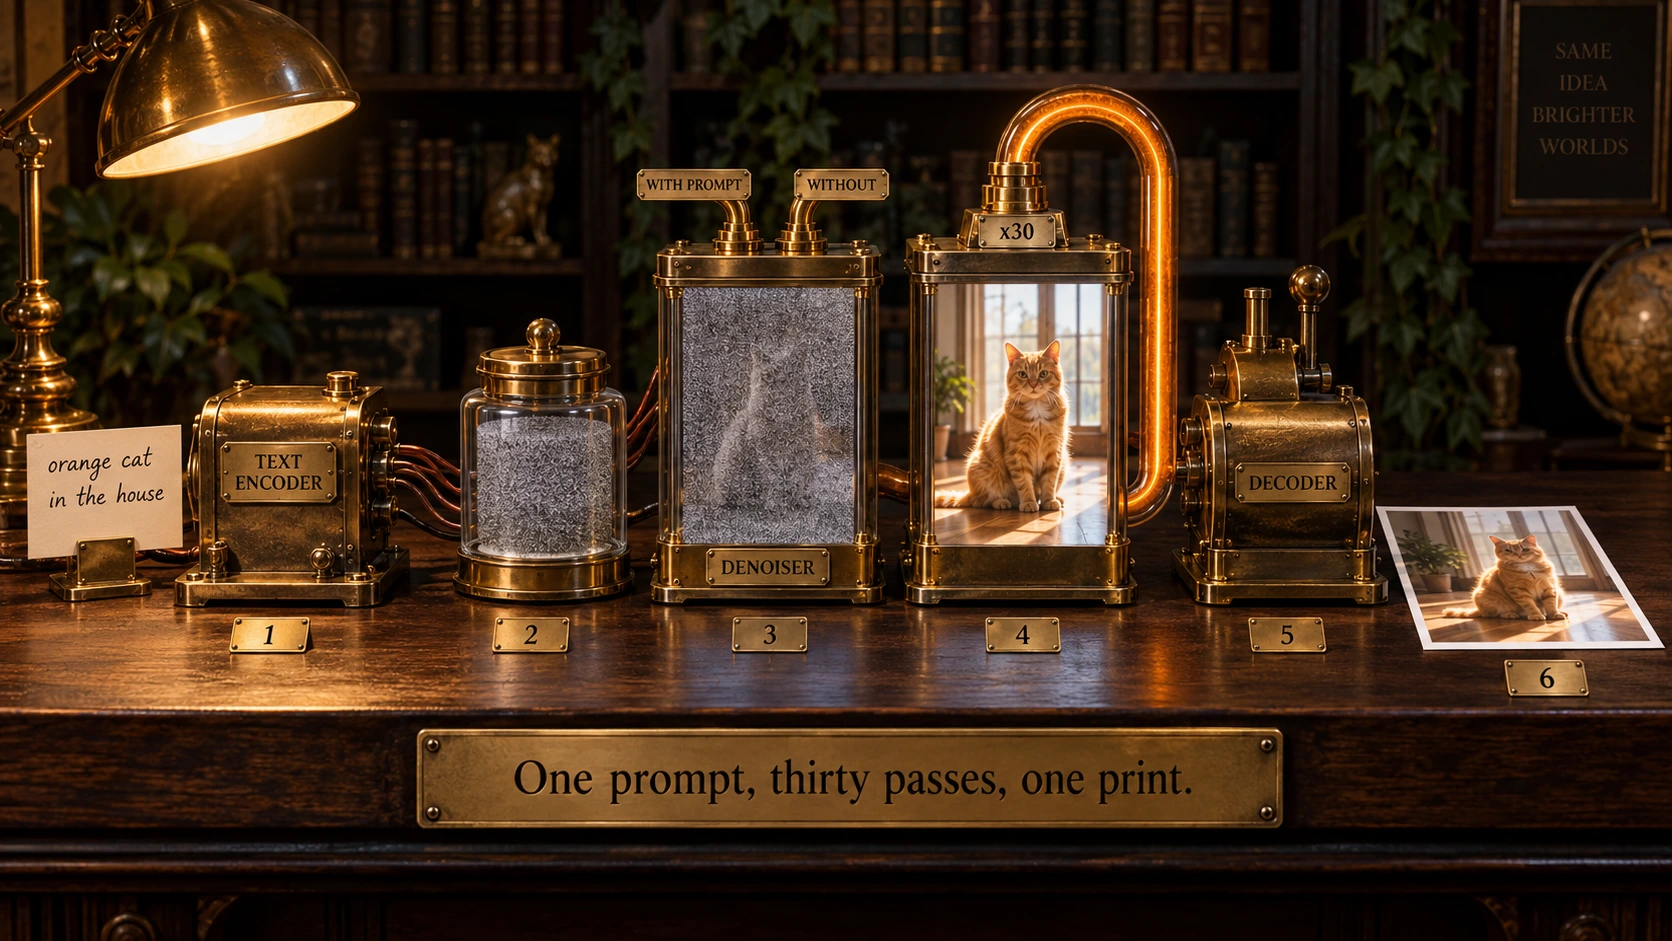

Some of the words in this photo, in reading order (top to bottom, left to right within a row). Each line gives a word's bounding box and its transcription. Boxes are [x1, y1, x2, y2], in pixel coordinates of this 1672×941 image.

[1555, 42, 1612, 59] SAME
[1560, 74, 1608, 91] IDEA
[1533, 106, 1635, 123] BRIGHTER
[1539, 138, 1629, 155] WORLDS
[646, 178, 683, 191] WITH
[687, 178, 743, 191] PROMPT
[807, 178, 877, 192] WITHOUT
[999, 222, 1034, 240] x30
[48, 456, 112, 482] orange
[121, 446, 153, 468] cat
[254, 454, 303, 470] TEXT
[235, 475, 323, 491] ENCODER
[1249, 475, 1338, 491] DECODER
[49, 491, 67, 509] in
[76, 484, 106, 507] the
[116, 482, 165, 504] house
[721, 559, 815, 575] DENOISER
[263, 624, 274, 645] 1
[523, 624, 538, 645] 2
[763, 624, 777, 645] 3
[1015, 624, 1031, 645] 4
[1280, 624, 1294, 645] 5
[1539, 667, 1555, 689] 6
[514, 759, 593, 795] One
[610, 764, 755, 805] prompt,
[769, 758, 871, 805] thirty
[884, 770, 1007, 805] passes,
[1021, 770, 1085, 795] one
[1098, 759, 1192, 805] print.
